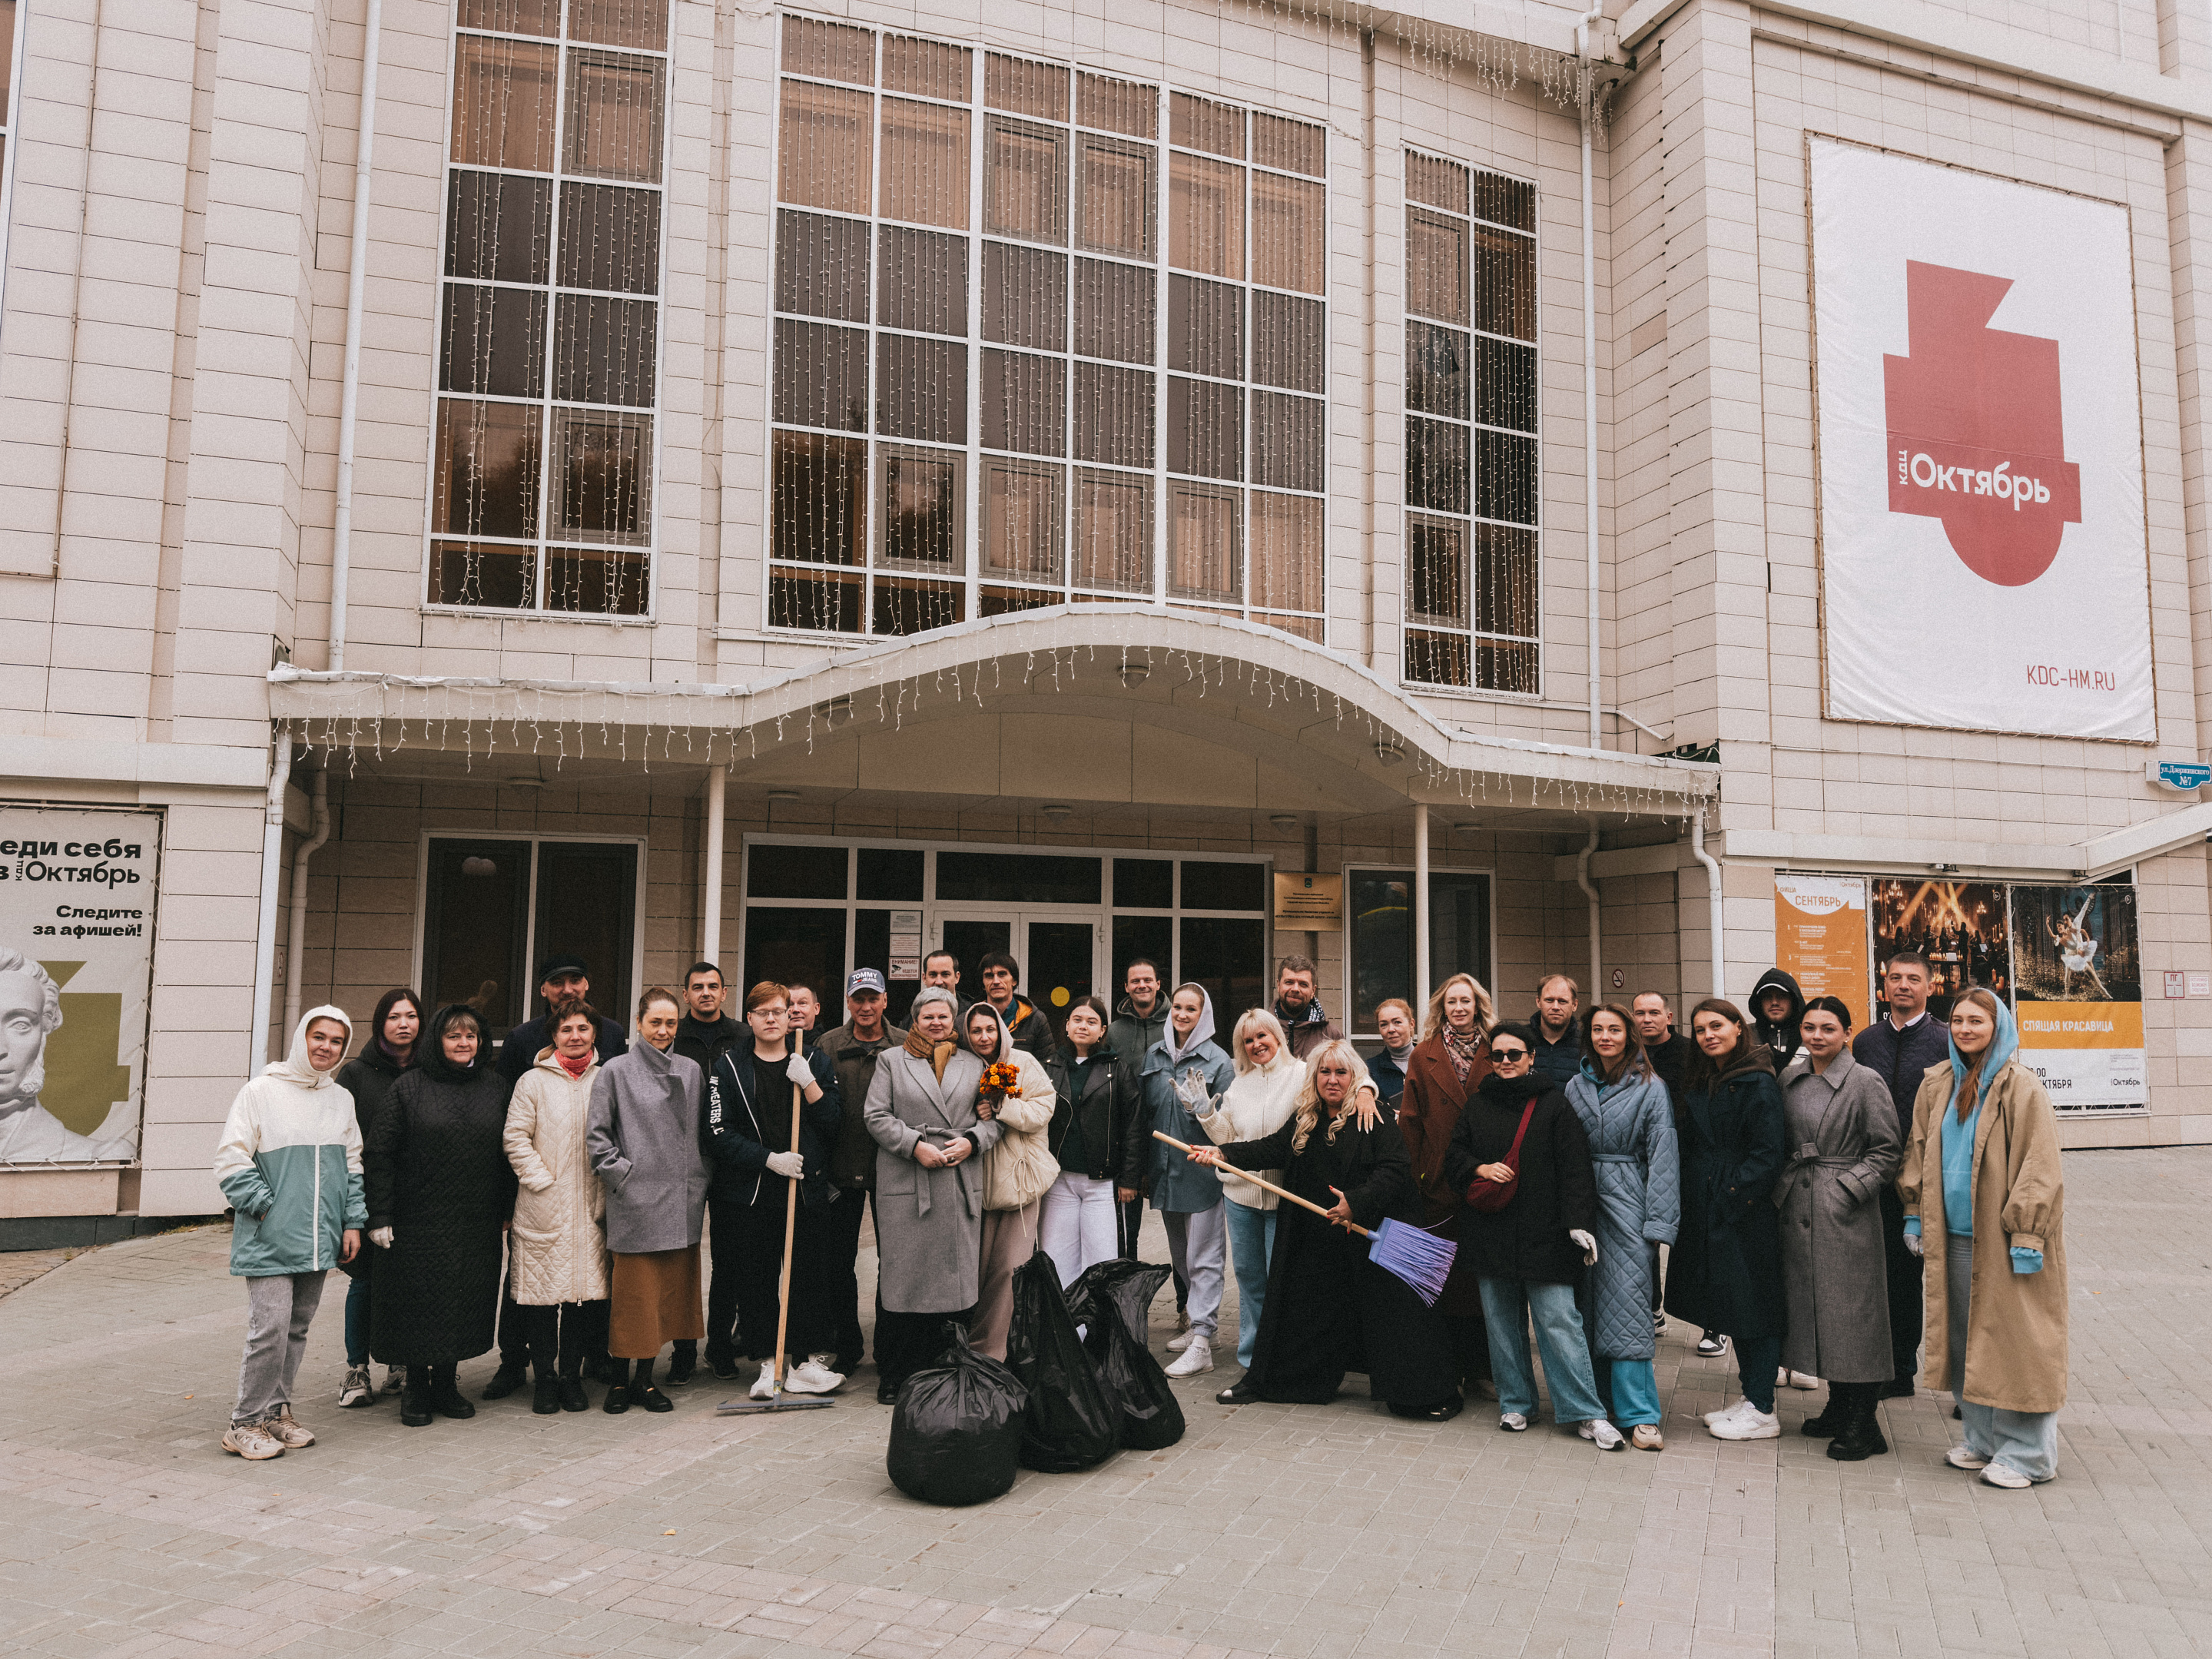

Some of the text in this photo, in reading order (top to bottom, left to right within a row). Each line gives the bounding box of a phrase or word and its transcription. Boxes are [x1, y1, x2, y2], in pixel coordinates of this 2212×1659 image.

[1910, 453, 2050, 511] Октябрь
[2027, 665, 2115, 691] KDC-HM.RU
[65, 838, 141, 858] себя
[25, 861, 141, 889] Октябрь
[1795, 895, 1841, 907] СЕНТЯБРЬ
[56, 905, 143, 920] Следите
[33, 924, 142, 939] за афишей!
[851, 971, 877, 980] TOMMY
[2023, 1020, 2114, 1033] СПЯЩАЯ КРАСАВИЦА
[2040, 1079, 2072, 1089] КТЯБРЯ
[2113, 1077, 2141, 1087] Октябрь
